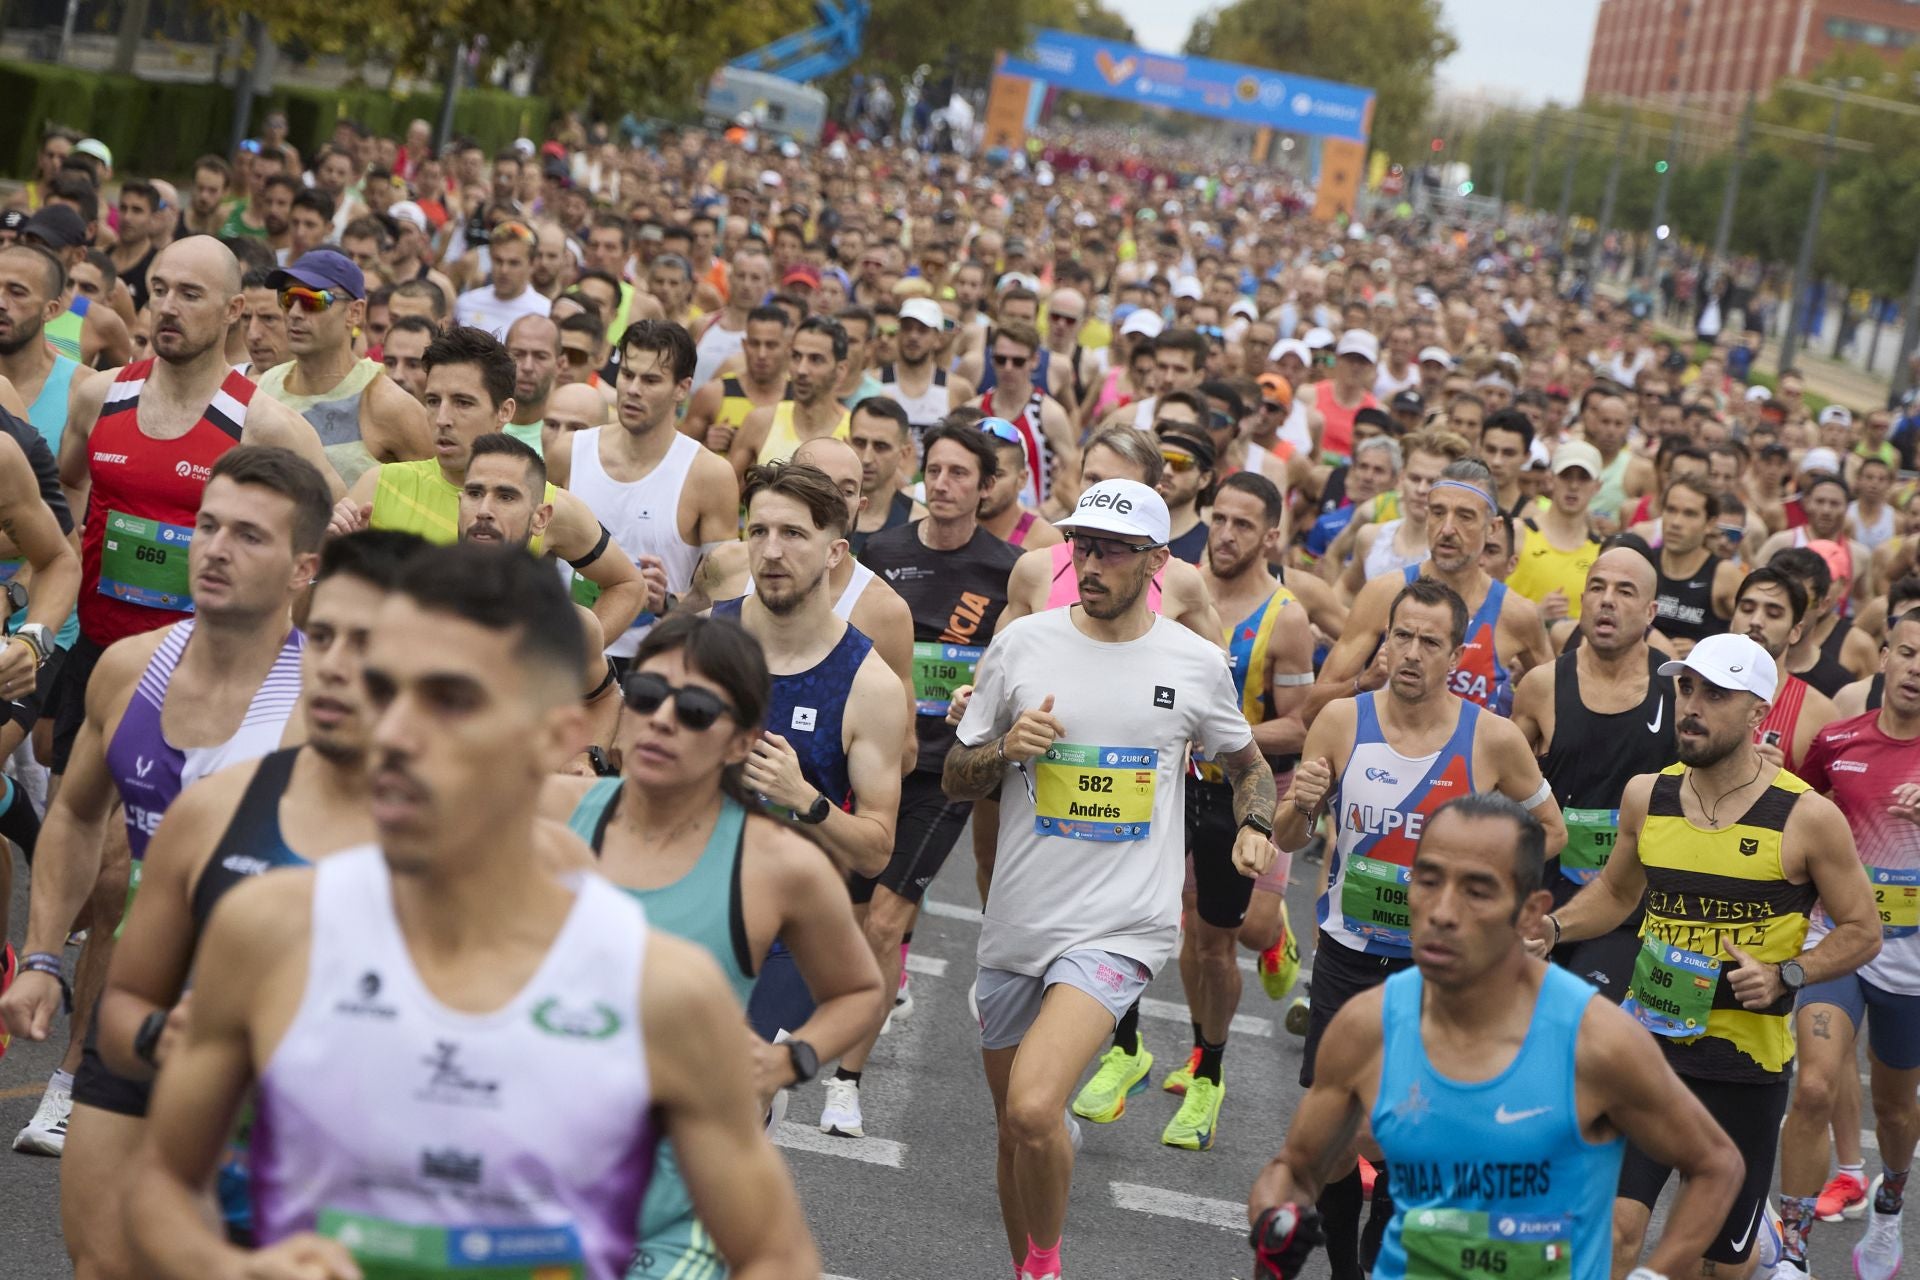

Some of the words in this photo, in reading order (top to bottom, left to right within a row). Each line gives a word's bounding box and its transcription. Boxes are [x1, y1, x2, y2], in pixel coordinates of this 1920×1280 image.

[94, 451, 128, 464] TRIMTEX
[1080, 489, 1132, 515] ciele
[136, 545, 166, 565] 669
[922, 664, 957, 680] 1150
[1121, 755, 1150, 764] ZURI
[1078, 774, 1113, 793] 582
[1429, 779, 1453, 787] FASTER
[1068, 801, 1120, 818] Andrés
[1346, 803, 1424, 840] ALPE
[1699, 897, 1775, 919] VESPA
[1372, 909, 1411, 927] MIKEL
[1683, 956, 1712, 969] ZURIC
[1649, 966, 1674, 988] 996
[1639, 985, 1681, 1016] Vendetta
[1452, 1158, 1552, 1201] MASTERS
[1520, 1222, 1562, 1234] ZURICH
[1460, 1248, 1508, 1273] 945
